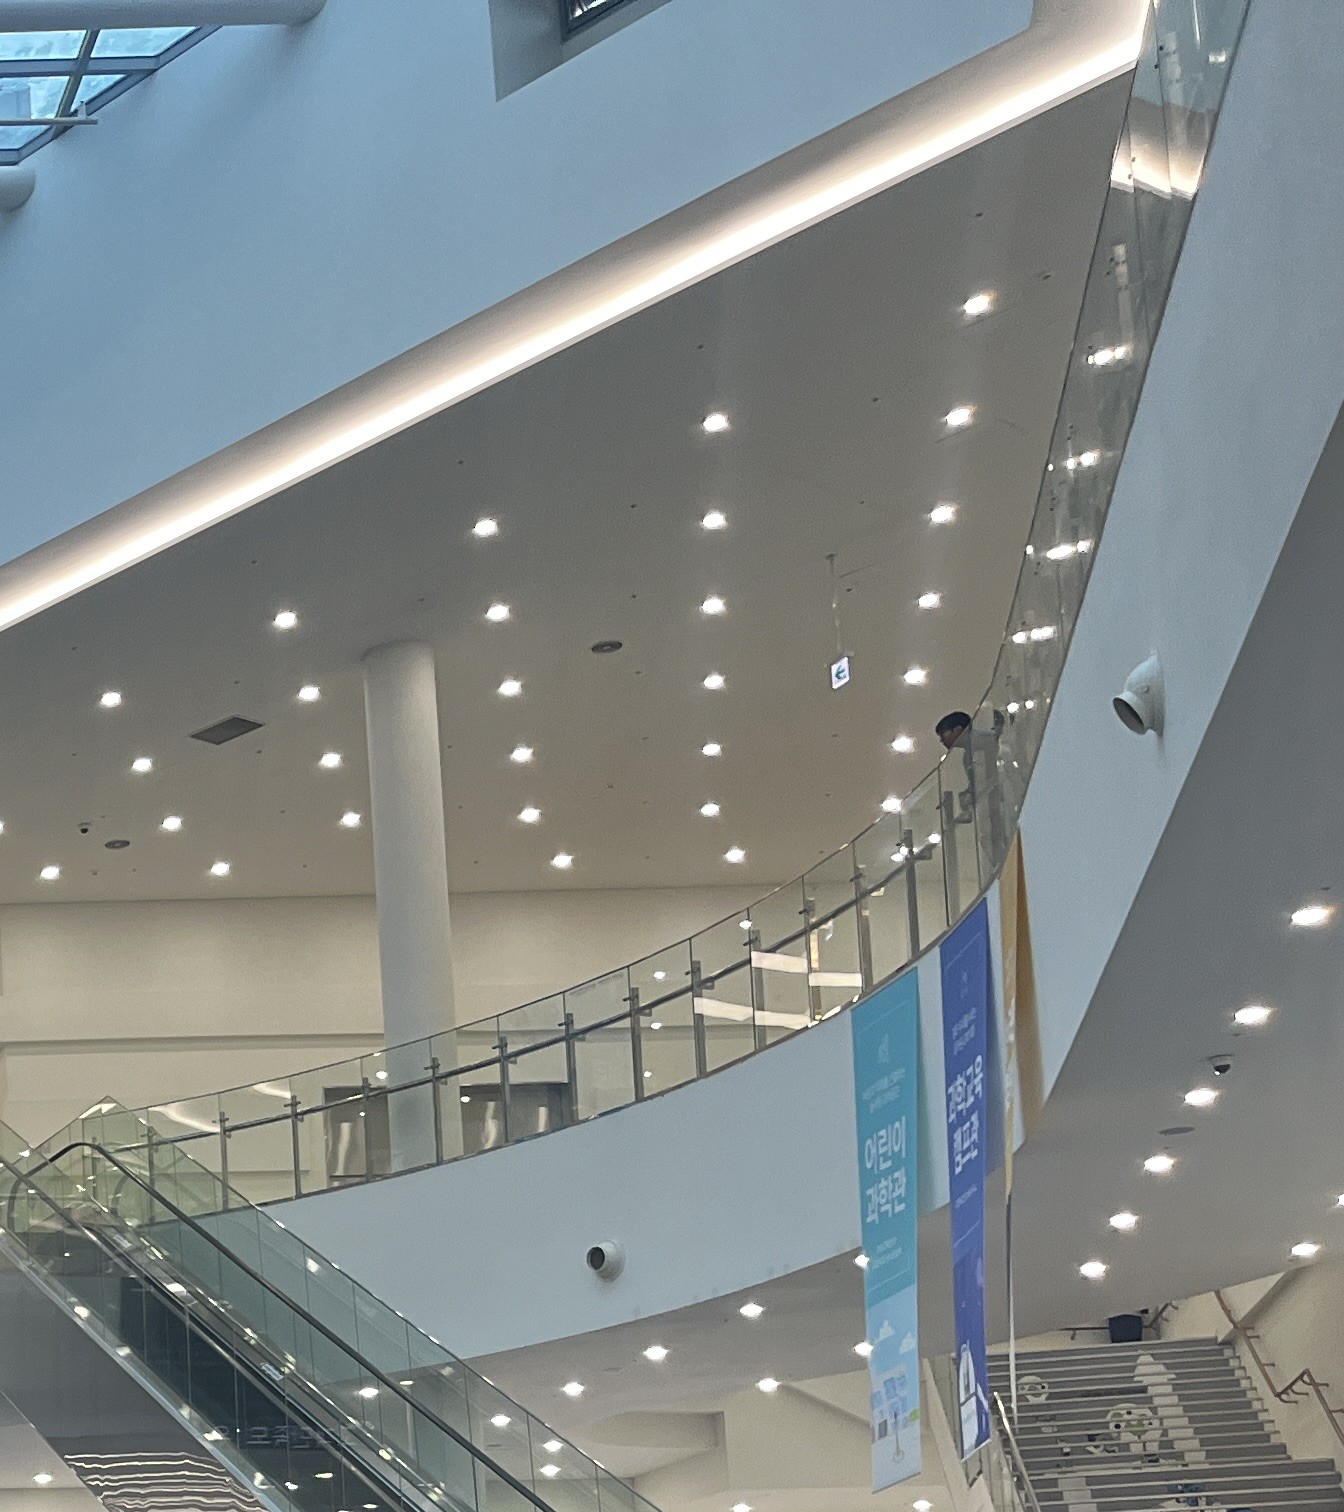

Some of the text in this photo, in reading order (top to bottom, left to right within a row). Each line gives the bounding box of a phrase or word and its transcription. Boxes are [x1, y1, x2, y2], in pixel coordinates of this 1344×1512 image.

[948, 1054, 984, 1124] 과학교육
[864, 1116, 906, 1174] 어린이
[866, 1166, 907, 1225] 과학관
